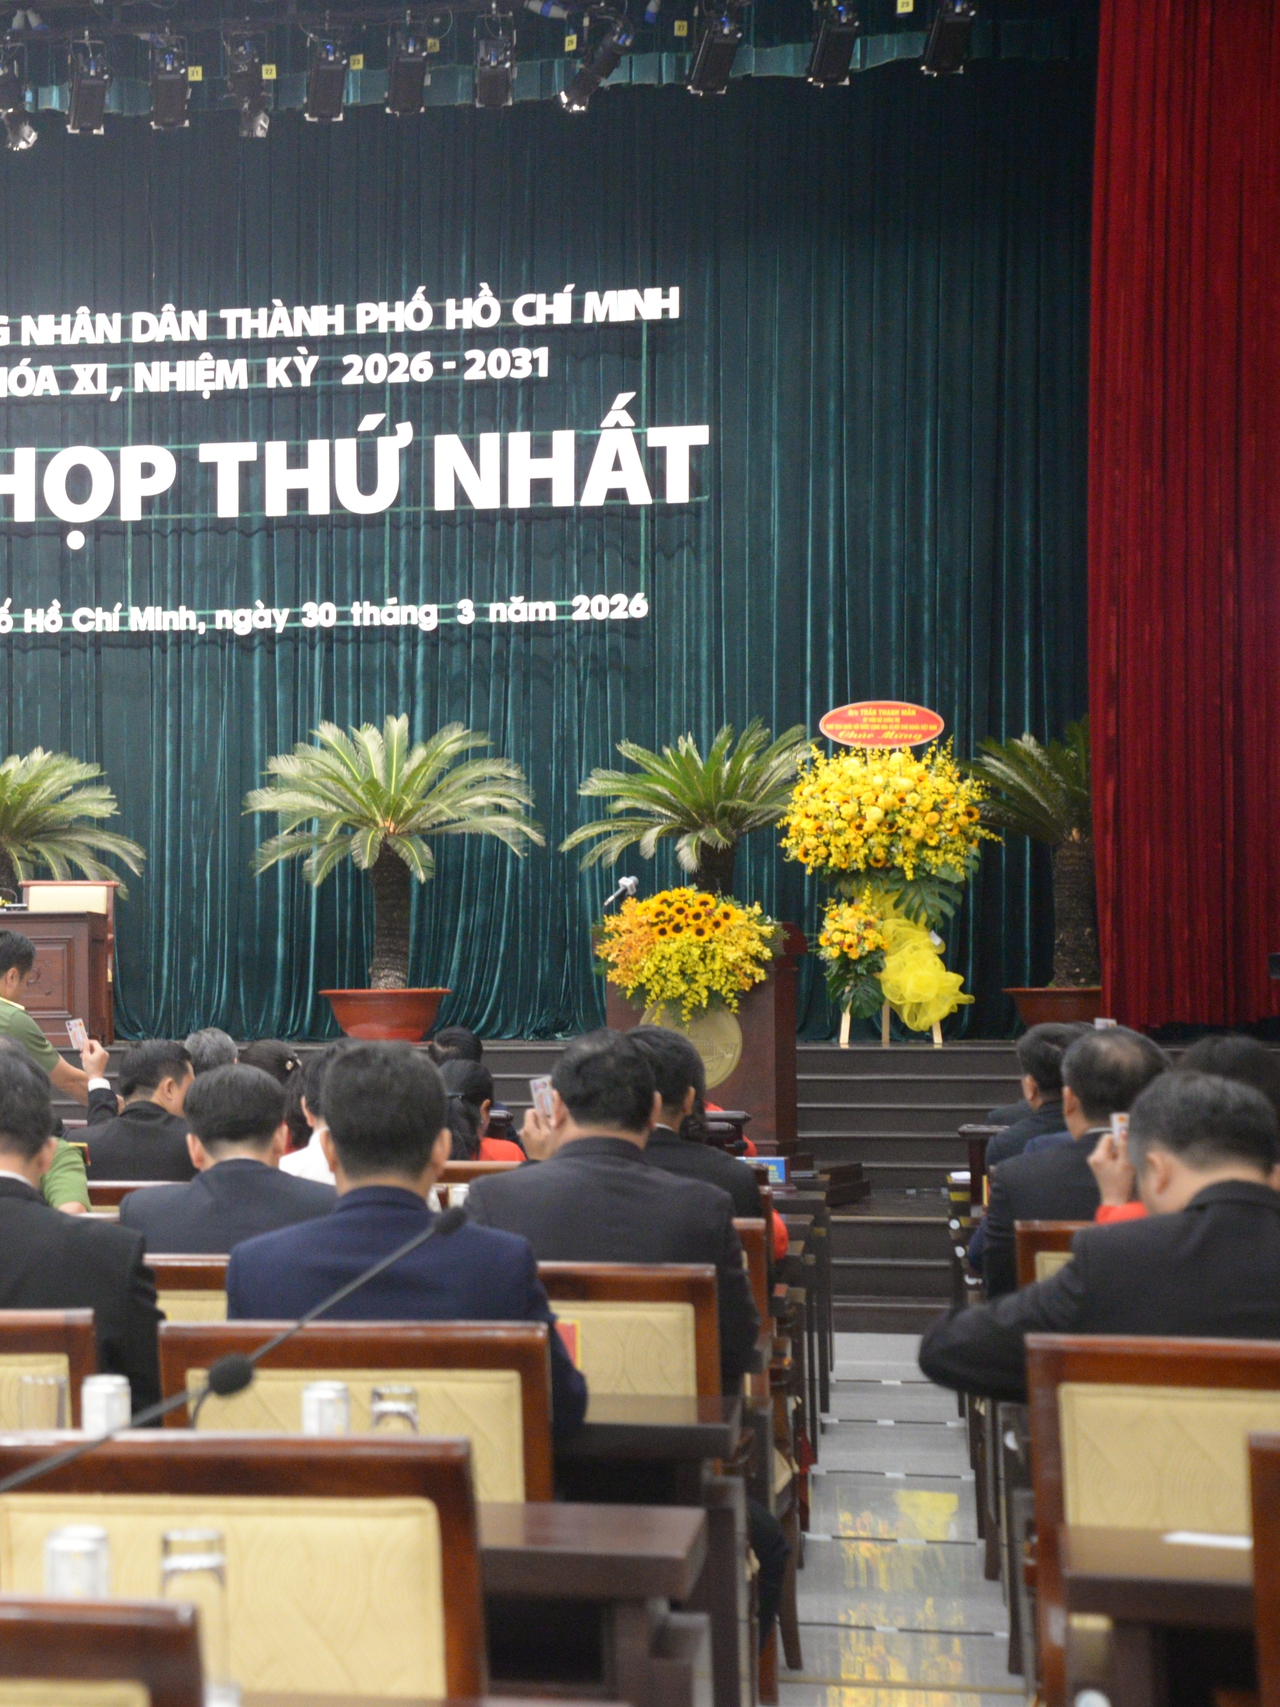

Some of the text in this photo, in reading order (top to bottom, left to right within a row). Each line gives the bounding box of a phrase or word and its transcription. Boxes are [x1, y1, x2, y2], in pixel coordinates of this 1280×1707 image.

[20, 305, 121, 347] NHÂN
[131, 303, 208, 343] DÂN
[219, 298, 345, 340] THÀNH
[355, 285, 434, 335] PHỐ
[445, 282, 502, 330] HỒ
[512, 283, 576, 327] CHÍ
[583, 286, 680, 324] MINH
[69, 362, 124, 402] XI,
[134, 351, 249, 400] NHIỆM
[266, 346, 320, 389] KỲ
[341, 350, 434, 386] 2026
[442, 360, 457, 370] -
[463, 346, 549, 381] 2031
[198, 411, 414, 519] THỨ
[433, 391, 710, 512] NHẤT
[22, 598, 64, 634] Hồ
[71, 601, 123, 633] Chí
[128, 605, 207, 635] Minh,
[214, 599, 291, 636] ngày
[300, 601, 338, 628] 30
[349, 596, 439, 632] tháng
[456, 598, 476, 625] 3
[488, 595, 558, 623] năm
[570, 592, 650, 621] 2026
